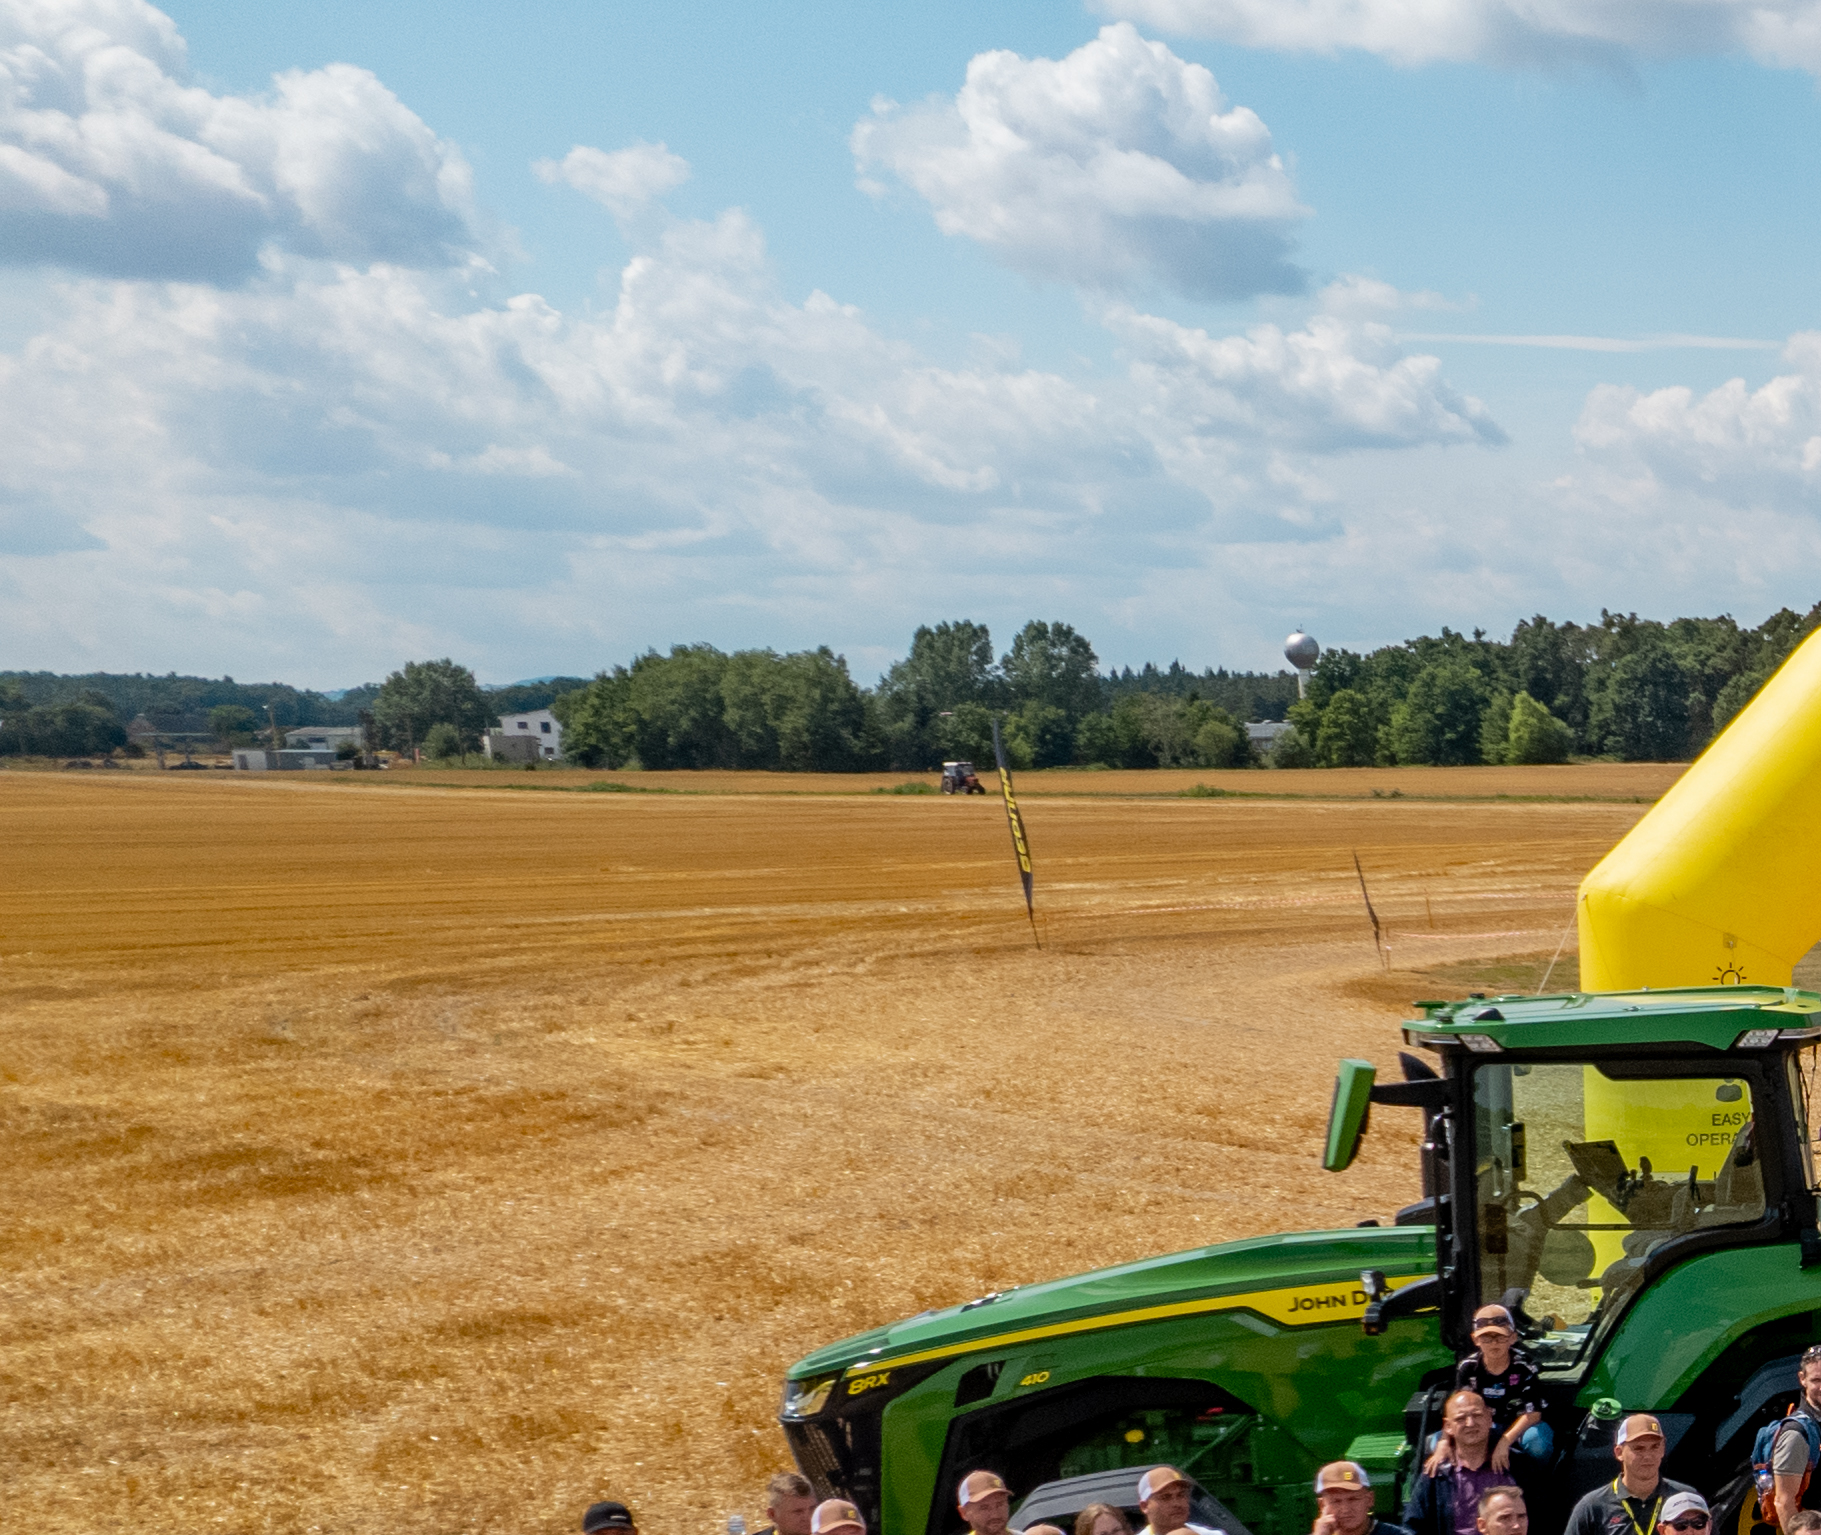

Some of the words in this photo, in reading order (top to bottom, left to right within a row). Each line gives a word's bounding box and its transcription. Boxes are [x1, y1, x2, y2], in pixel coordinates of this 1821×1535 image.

[1711, 1112, 1751, 1127] EASY
[1288, 1291, 1347, 1313] JOHN
[848, 1371, 891, 1395] 8RX
[1020, 1371, 1050, 1386] 410
